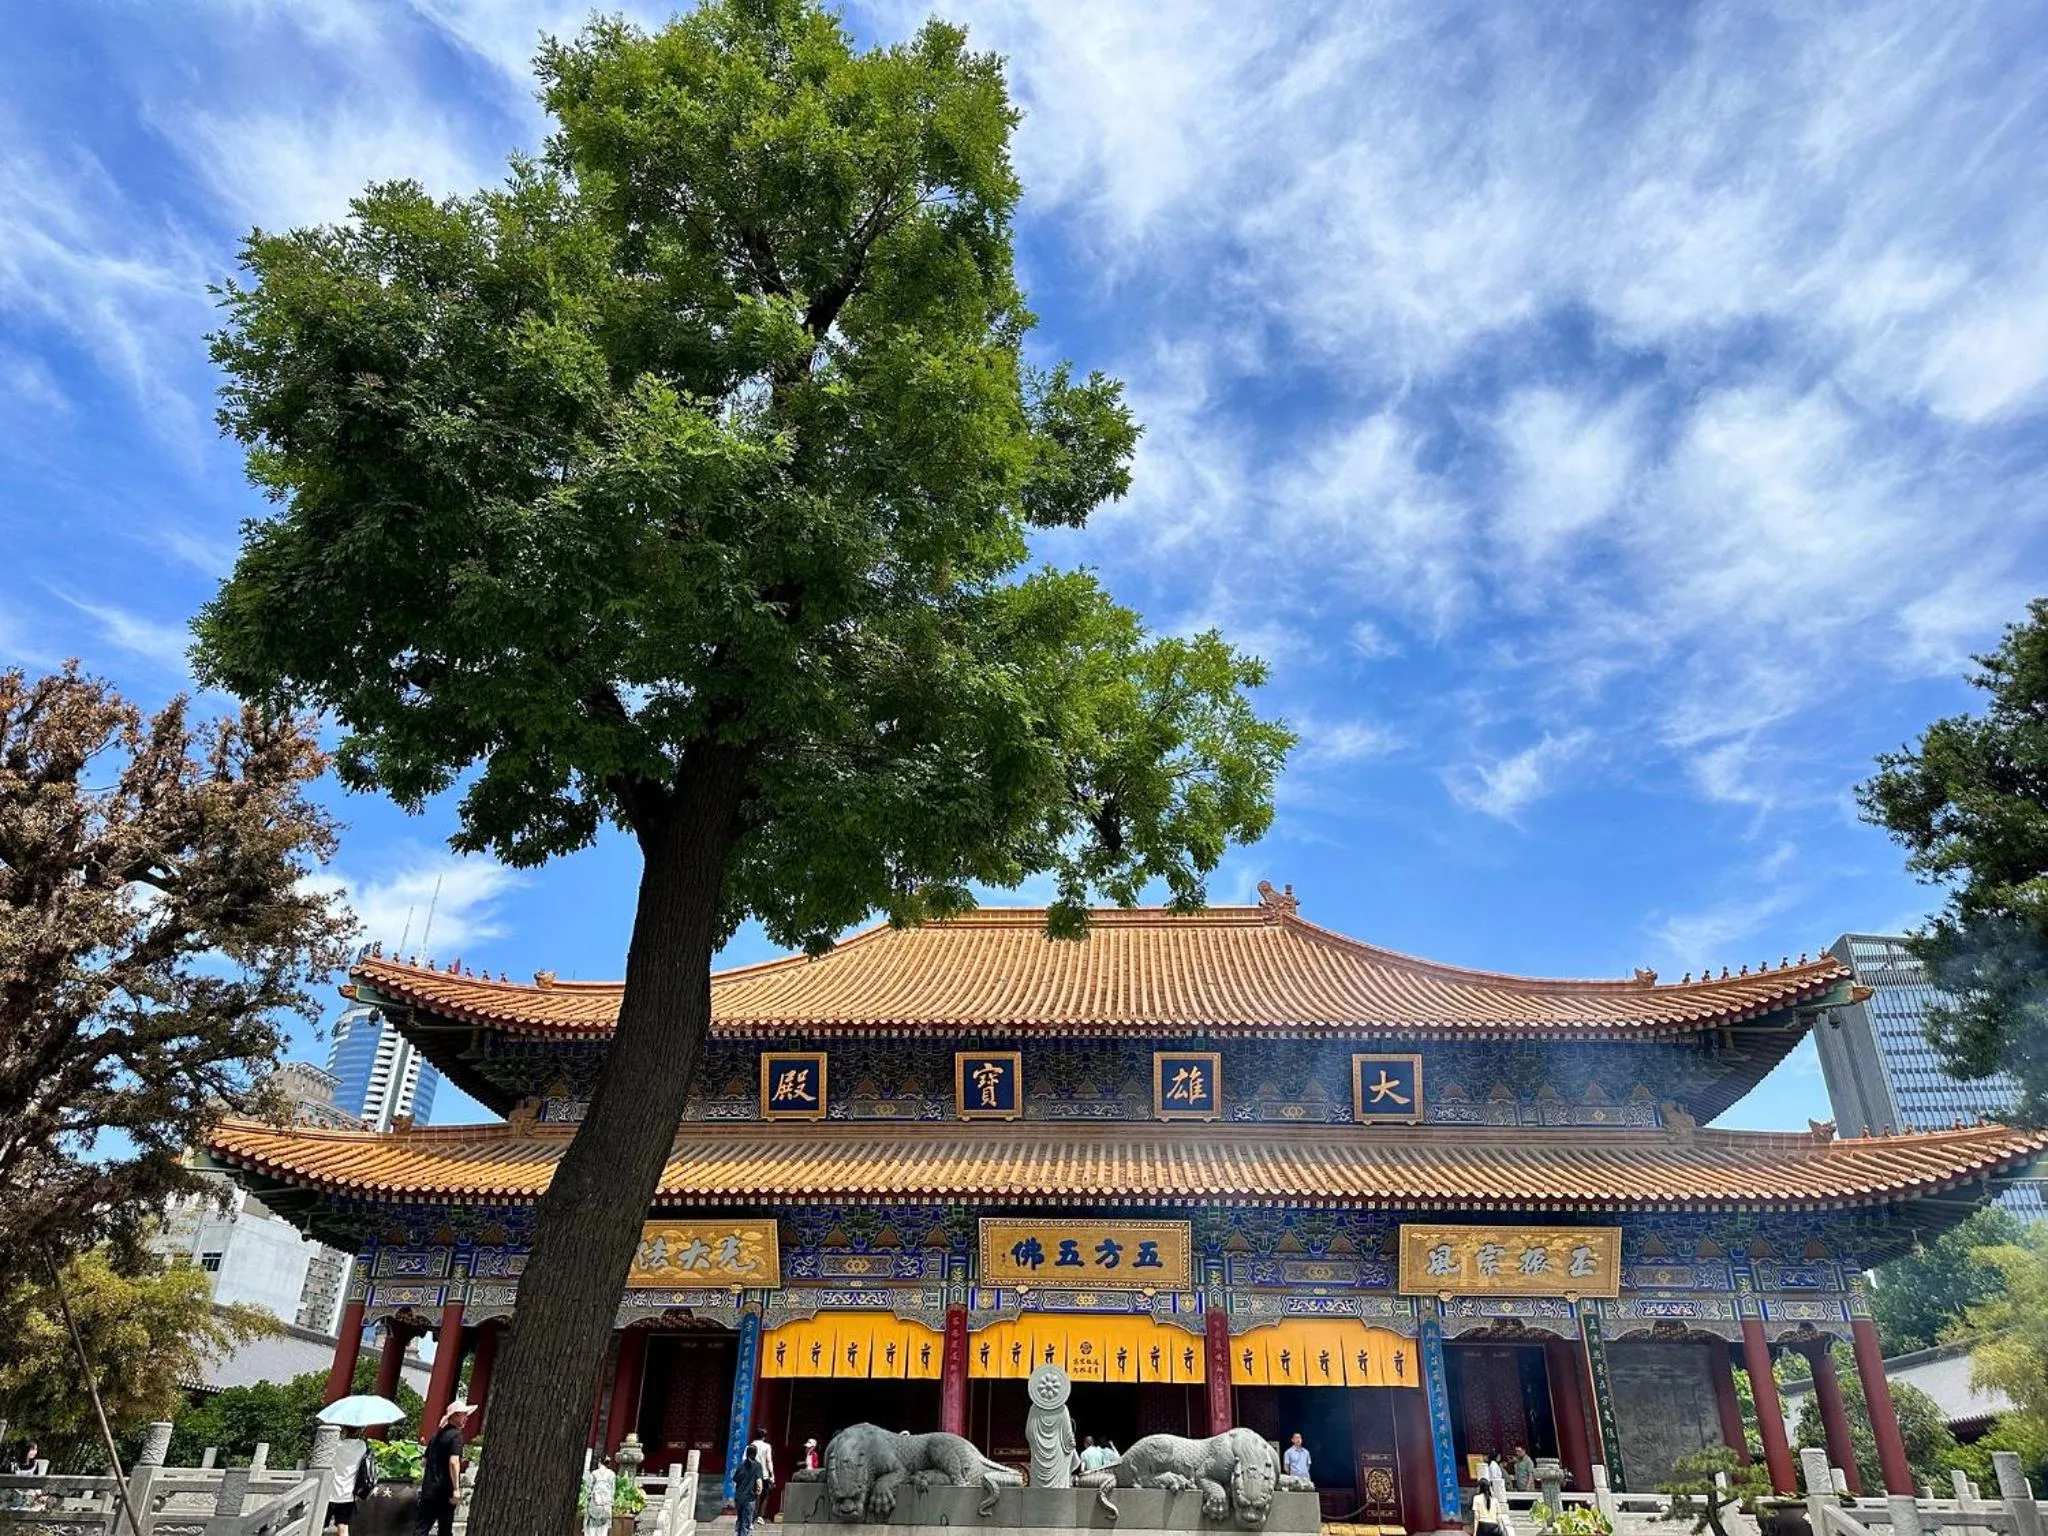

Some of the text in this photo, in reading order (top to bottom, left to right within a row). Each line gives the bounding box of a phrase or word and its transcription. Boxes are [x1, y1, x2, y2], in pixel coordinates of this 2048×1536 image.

[771, 1067, 816, 1103] 殿
[971, 1062, 1004, 1107] 寶
[1165, 1066, 1208, 1105] 雄
[1368, 1067, 1411, 1104] 大
[636, 1233, 758, 1272] 光大法
[1010, 1236, 1163, 1271] 五方五佛
